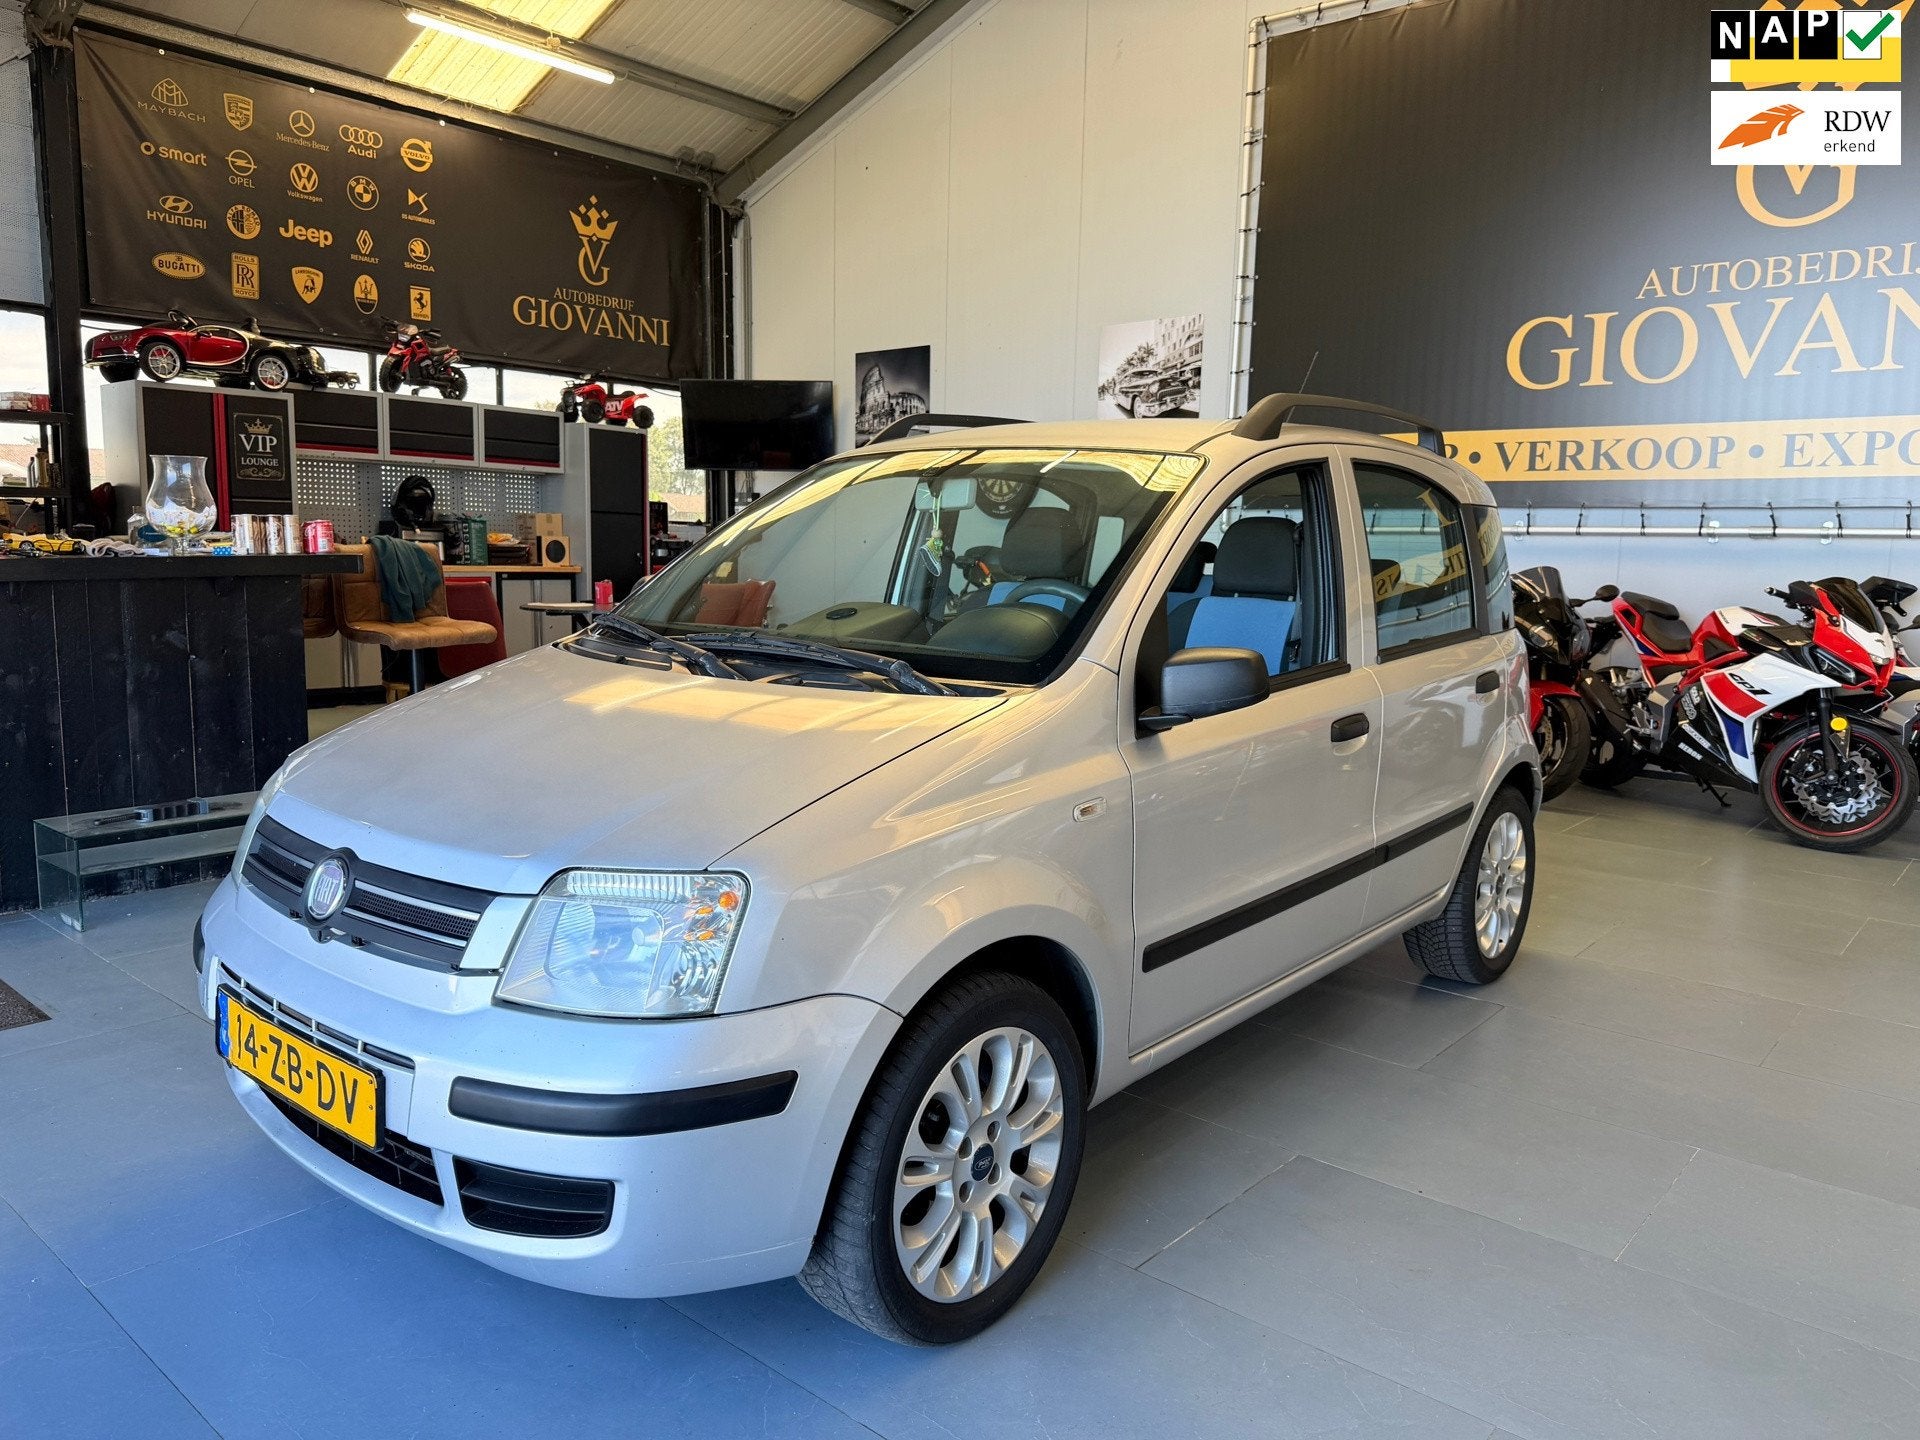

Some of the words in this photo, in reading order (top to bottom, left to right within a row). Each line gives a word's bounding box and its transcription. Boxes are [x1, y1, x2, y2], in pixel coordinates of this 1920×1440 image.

[137, 101, 206, 123] MAYBACH
[276, 132, 331, 152] Mercedes-Benz
[347, 144, 377, 159] Audi
[158, 146, 207, 167] smart
[404, 150, 431, 160] VOLVO
[228, 175, 256, 189] OPEL
[350, 178, 376, 191] BMW
[286, 189, 323, 203] Volkswagen
[146, 209, 207, 230] HYUNDAI
[278, 218, 333, 248] Jeep
[158, 259, 200, 273] BUGATTI
[350, 253, 380, 265] RENAULT
[1635, 241, 1920, 300] AUTOBEDRI
[553, 286, 635, 312] AUTOBEDRIJF
[512, 295, 671, 347] GIOVANNI
[605, 400, 625, 412] ATV
[238, 433, 278, 453] VIP
[241, 456, 279, 468] LOUNGE
[1493, 435, 1736, 473] VERKOOP
[236, 1013, 359, 1124] 14-ZB-DV
